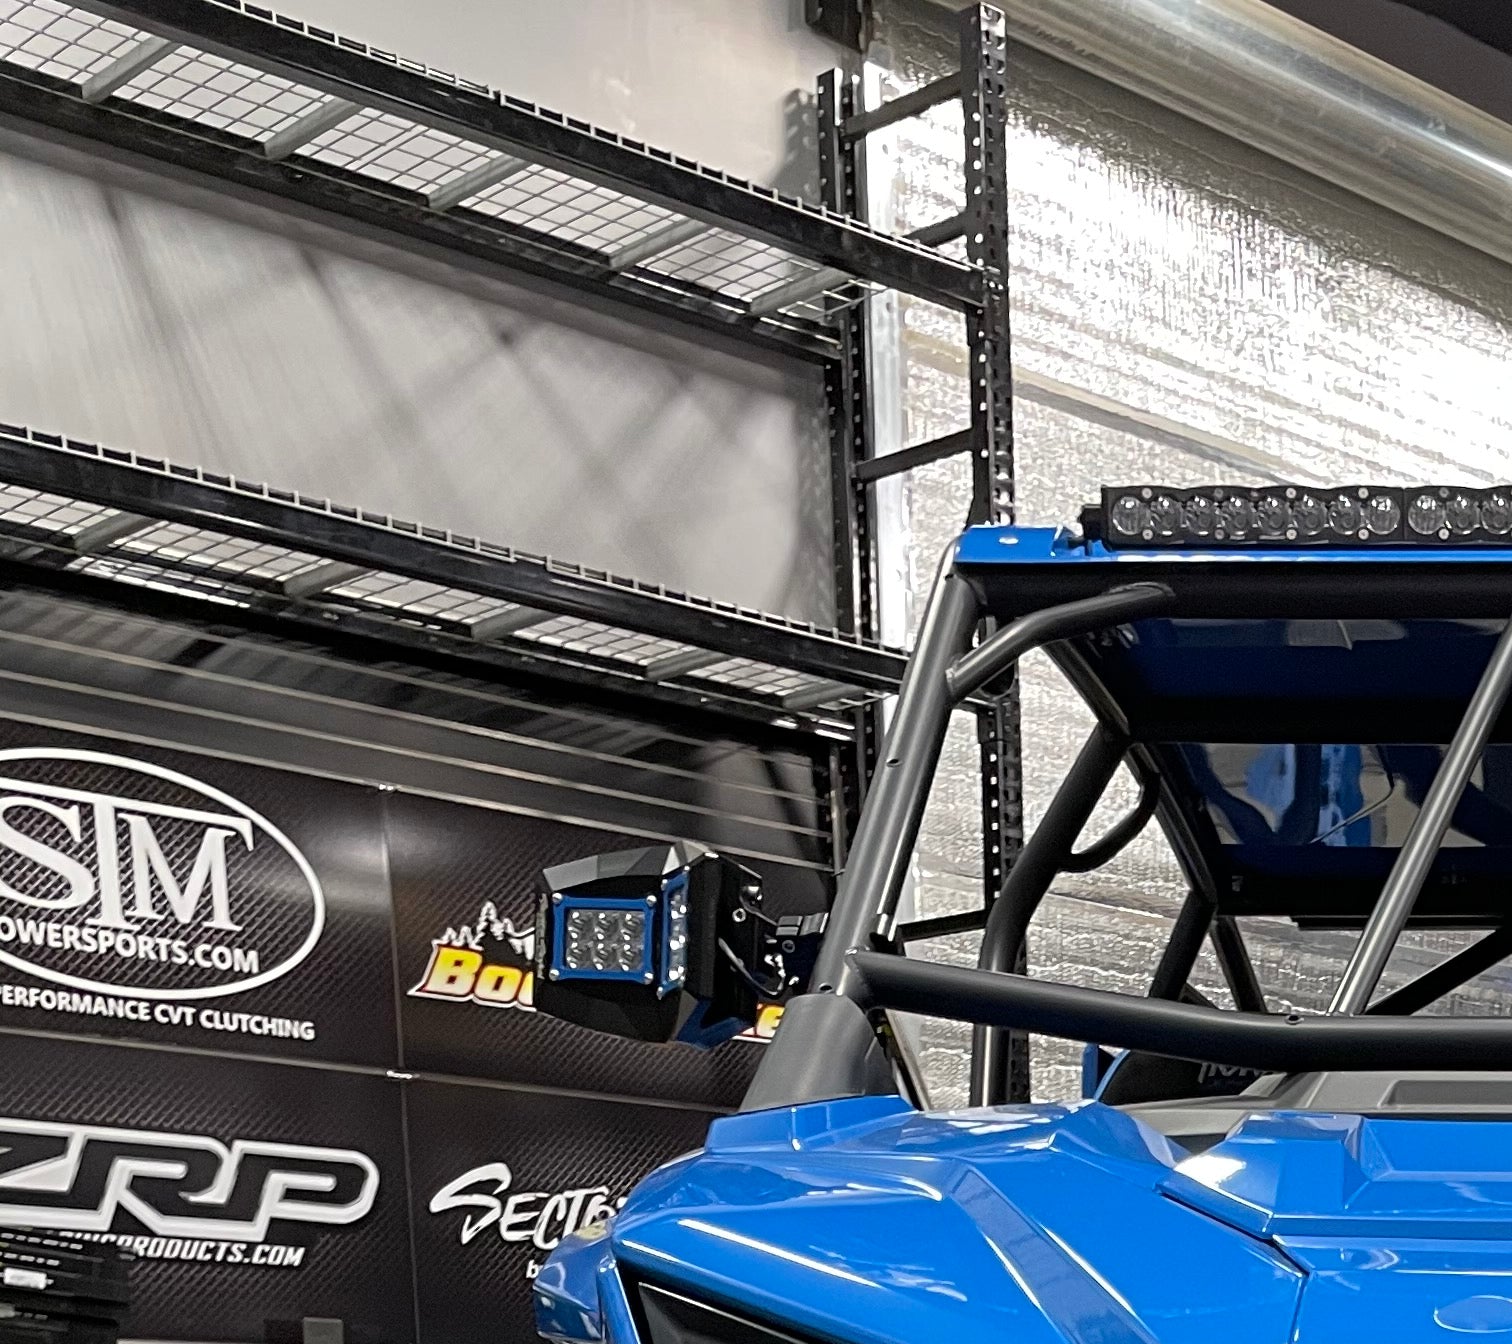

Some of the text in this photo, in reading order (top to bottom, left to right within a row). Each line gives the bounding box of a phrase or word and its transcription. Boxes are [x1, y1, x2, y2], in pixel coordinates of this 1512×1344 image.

[0, 777, 254, 931] STM
[0, 915, 260, 974] OWERSPORTS.COM
[0, 984, 316, 1041] ERFORMANCE CVT CLUTCHING
[0, 1117, 381, 1243] ZRP
